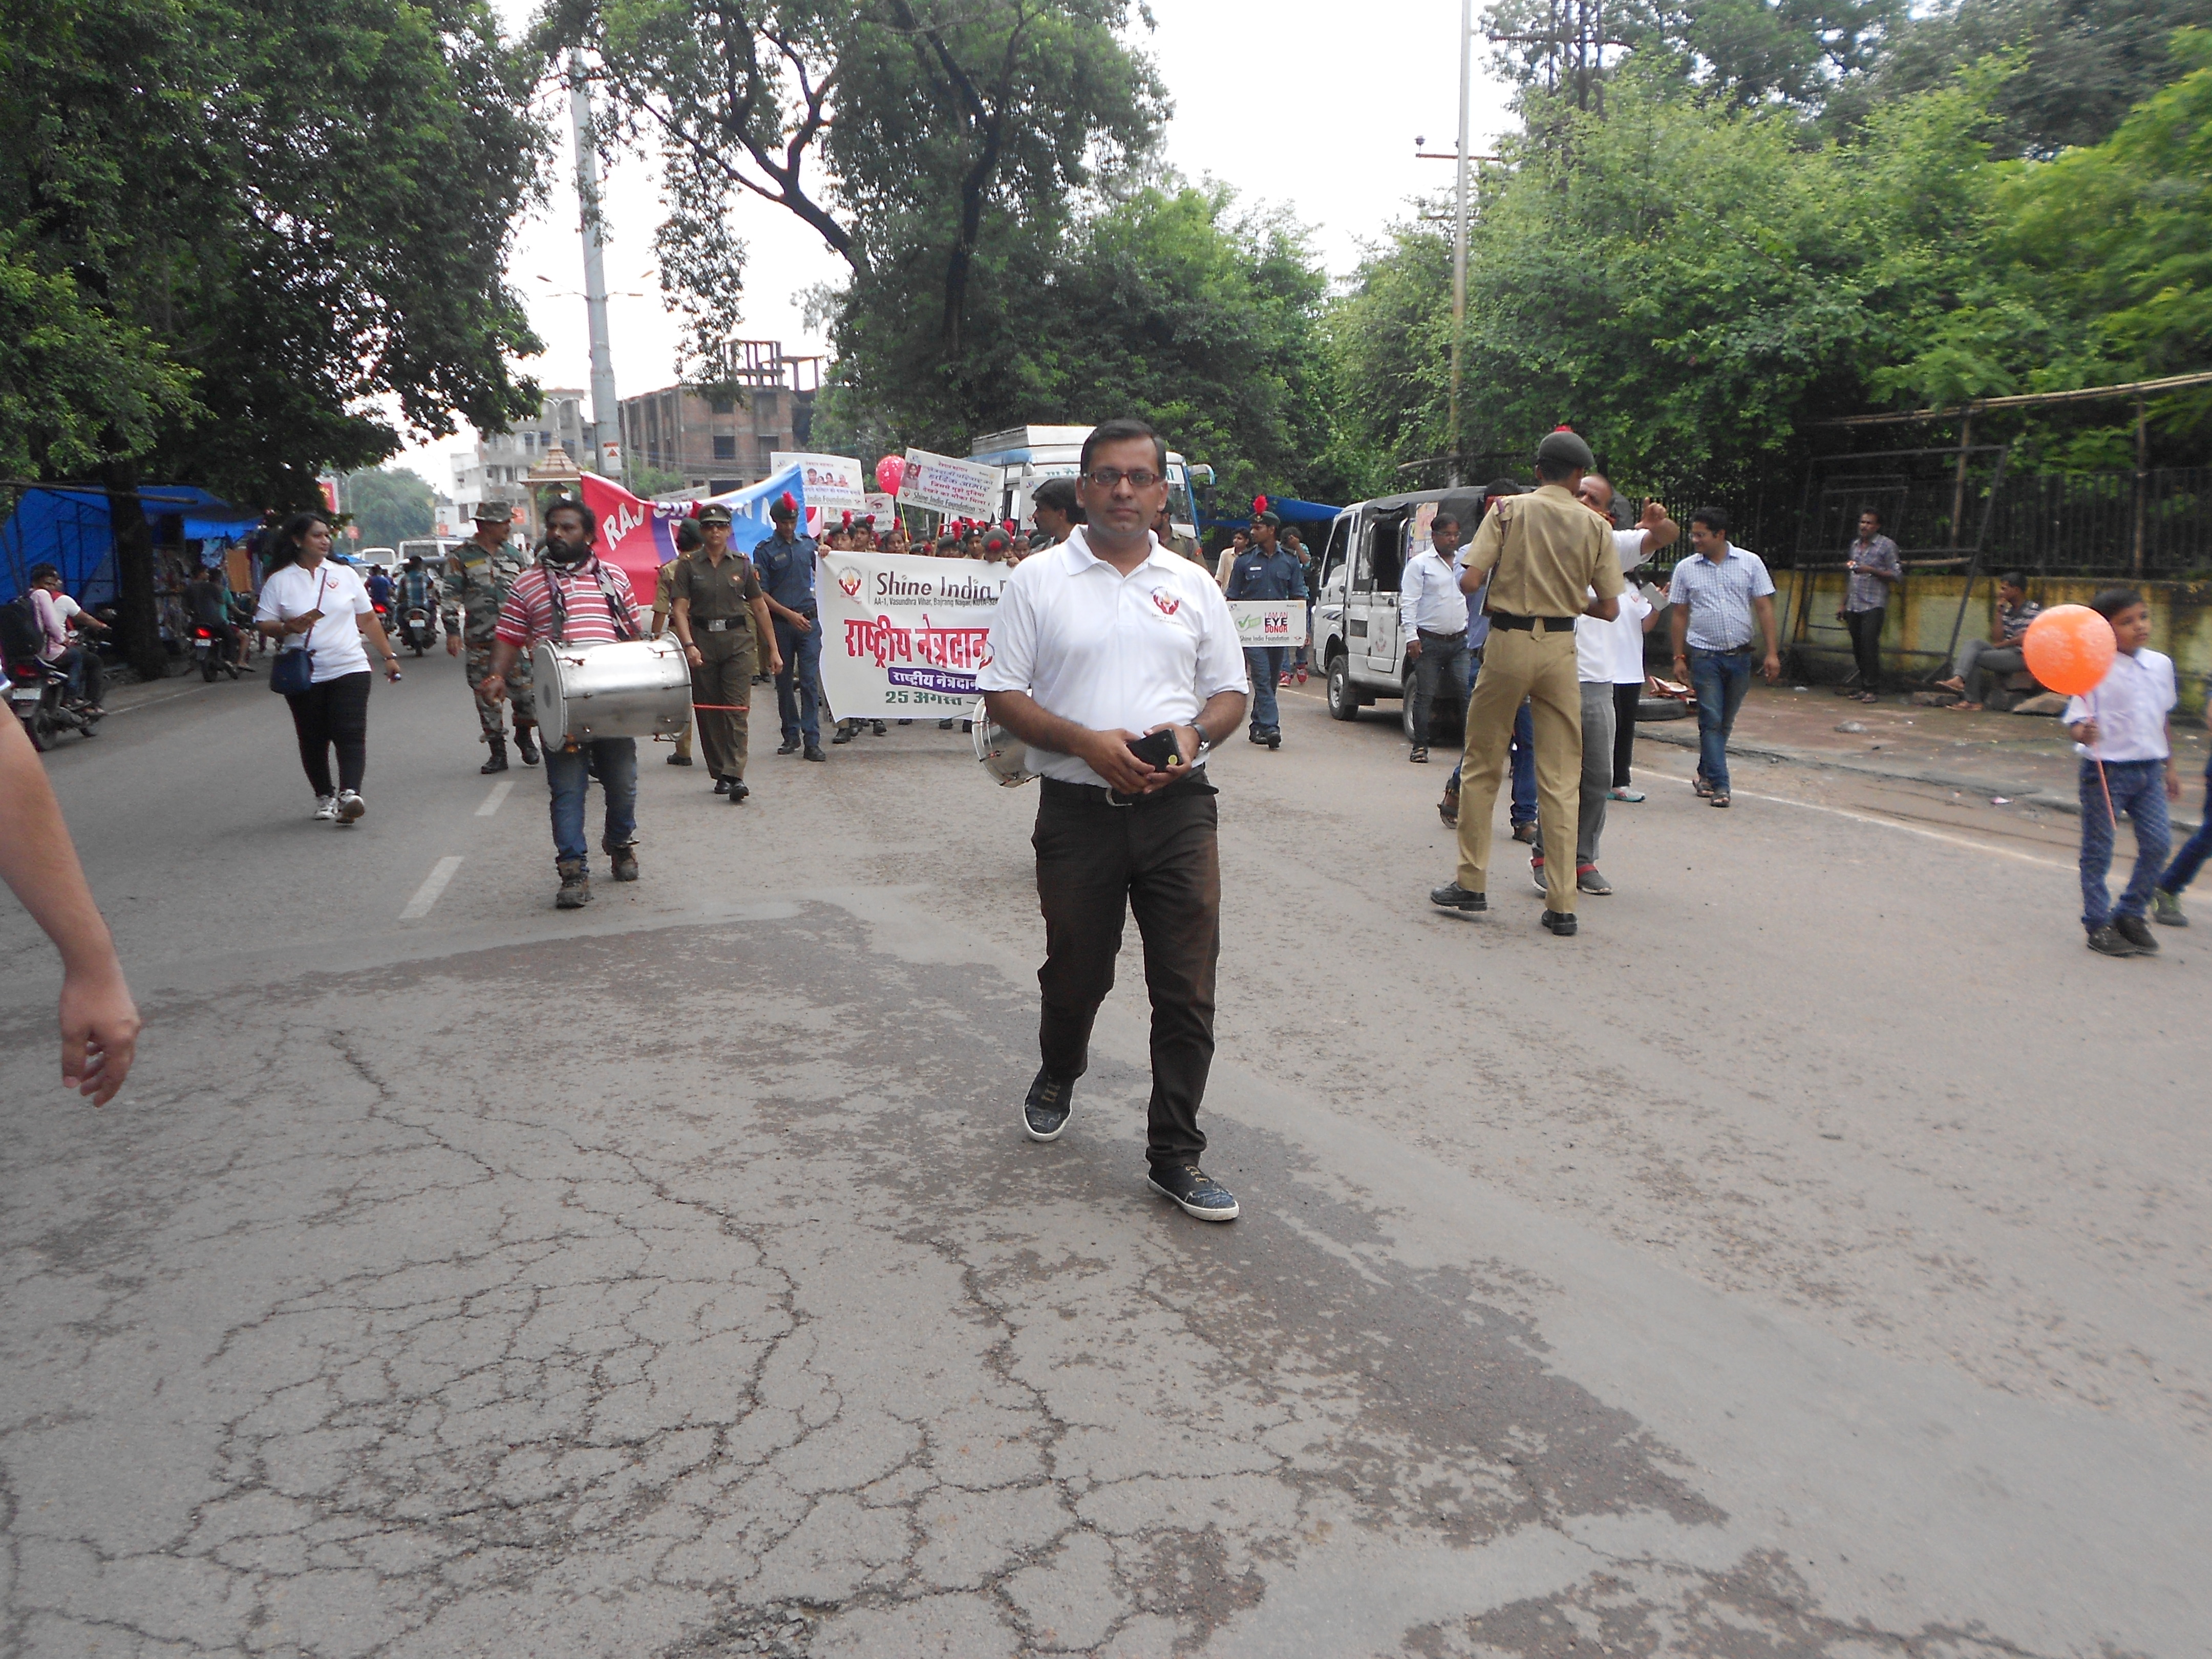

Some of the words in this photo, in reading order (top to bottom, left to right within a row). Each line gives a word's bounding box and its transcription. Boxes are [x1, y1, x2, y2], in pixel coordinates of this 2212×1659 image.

[913, 492, 928, 502] Shine
[930, 495, 944, 505] India
[945, 499, 975, 512] Foundation
[603, 502, 645, 551] RAJ
[877, 571, 932, 596] Shine
[940, 576, 991, 599] India
[874, 597, 888, 606] AA-1,
[918, 598, 932, 606] Vihar,
[933, 598, 953, 607] Bajrang
[955, 599, 972, 607] Nagar,
[844, 614, 912, 668] राष्ट्रीय
[915, 613, 990, 668] नेत्रदान
[892, 671, 935, 687] राष्ट्रीय
[886, 691, 909, 704] 25
[913, 691, 963, 706] अगस्त
